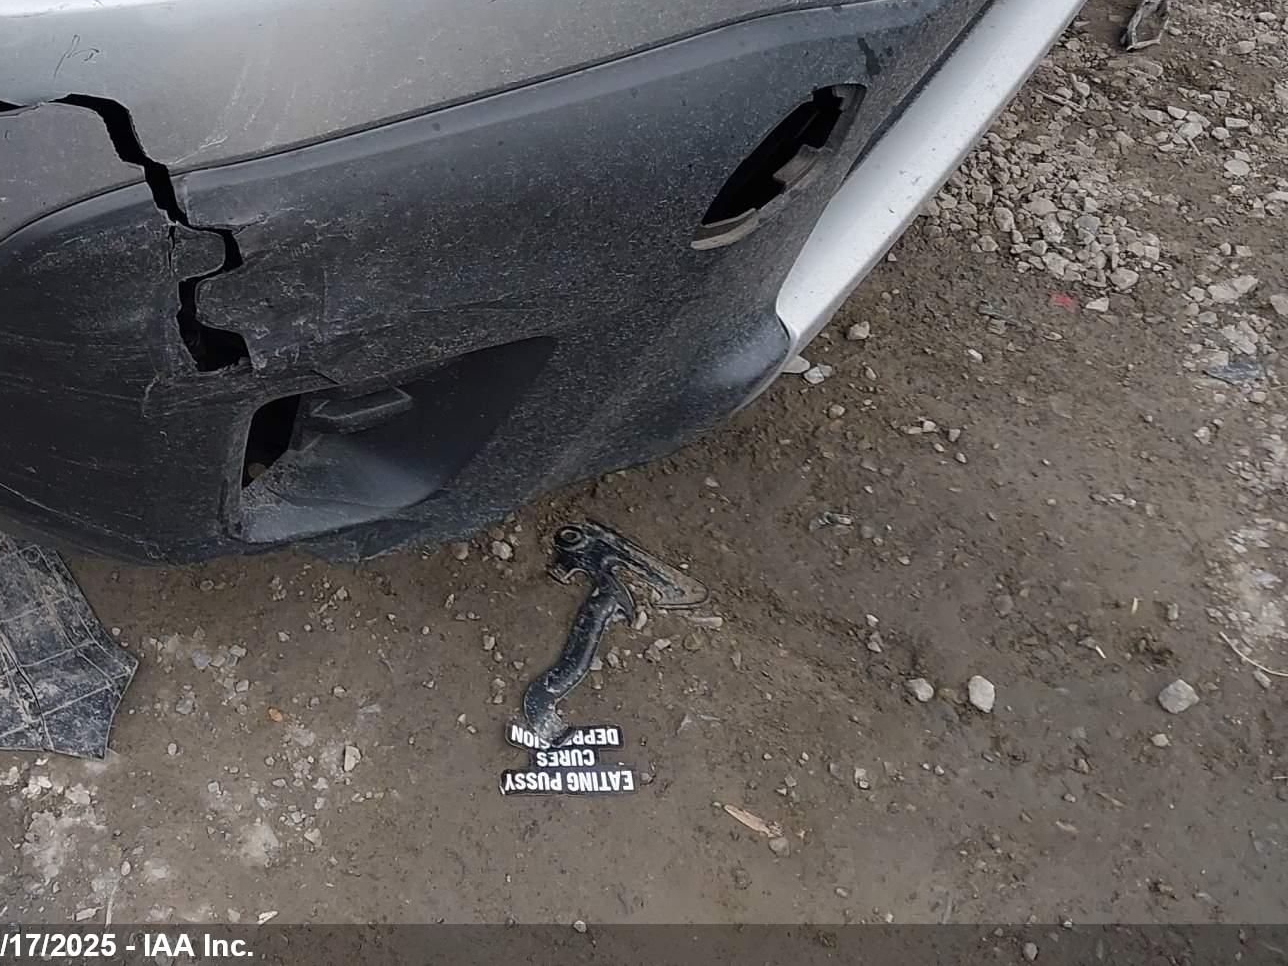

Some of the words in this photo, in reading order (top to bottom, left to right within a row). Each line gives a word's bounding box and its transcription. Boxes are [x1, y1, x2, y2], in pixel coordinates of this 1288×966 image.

[511, 724, 620, 750] DEPRSION
[536, 749, 595, 767] CURES
[504, 772, 563, 792] PUSSY
[567, 770, 635, 791] EATING
